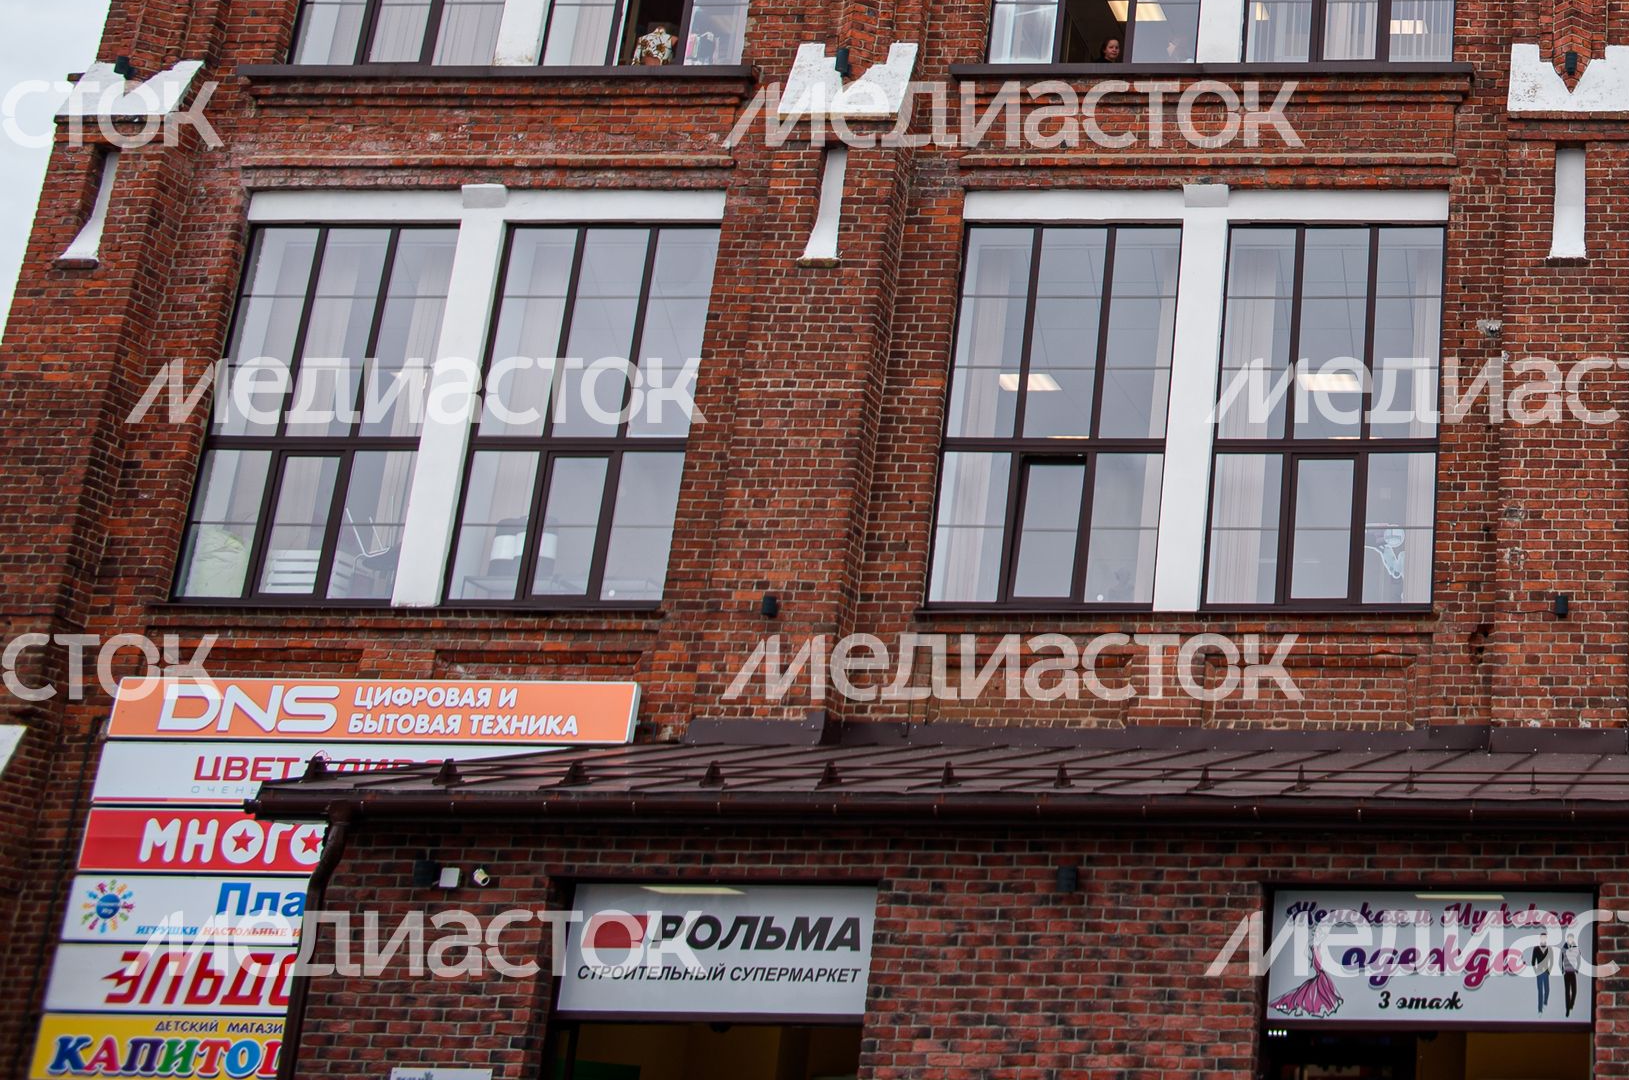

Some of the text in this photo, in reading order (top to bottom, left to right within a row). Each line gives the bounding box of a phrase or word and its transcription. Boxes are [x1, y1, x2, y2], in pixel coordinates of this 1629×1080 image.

[157, 683, 340, 733] DNS
[353, 686, 518, 710] ЦИФРОВАЯ И
[347, 713, 579, 737] БЫТОВАЯ ТЕХНИКА
[194, 755, 301, 782] ЦВЕТ
[135, 925, 199, 936] ИГРУШКИ
[650, 914, 862, 953] РОЛЬМА
[576, 962, 862, 984] СТРОИТЕЛЬНЫЙ СУПЕРМАРКЕТ
[1377, 991, 1464, 1010] 3 этаж
[154, 1019, 219, 1033] ДЕТСКИЙ
